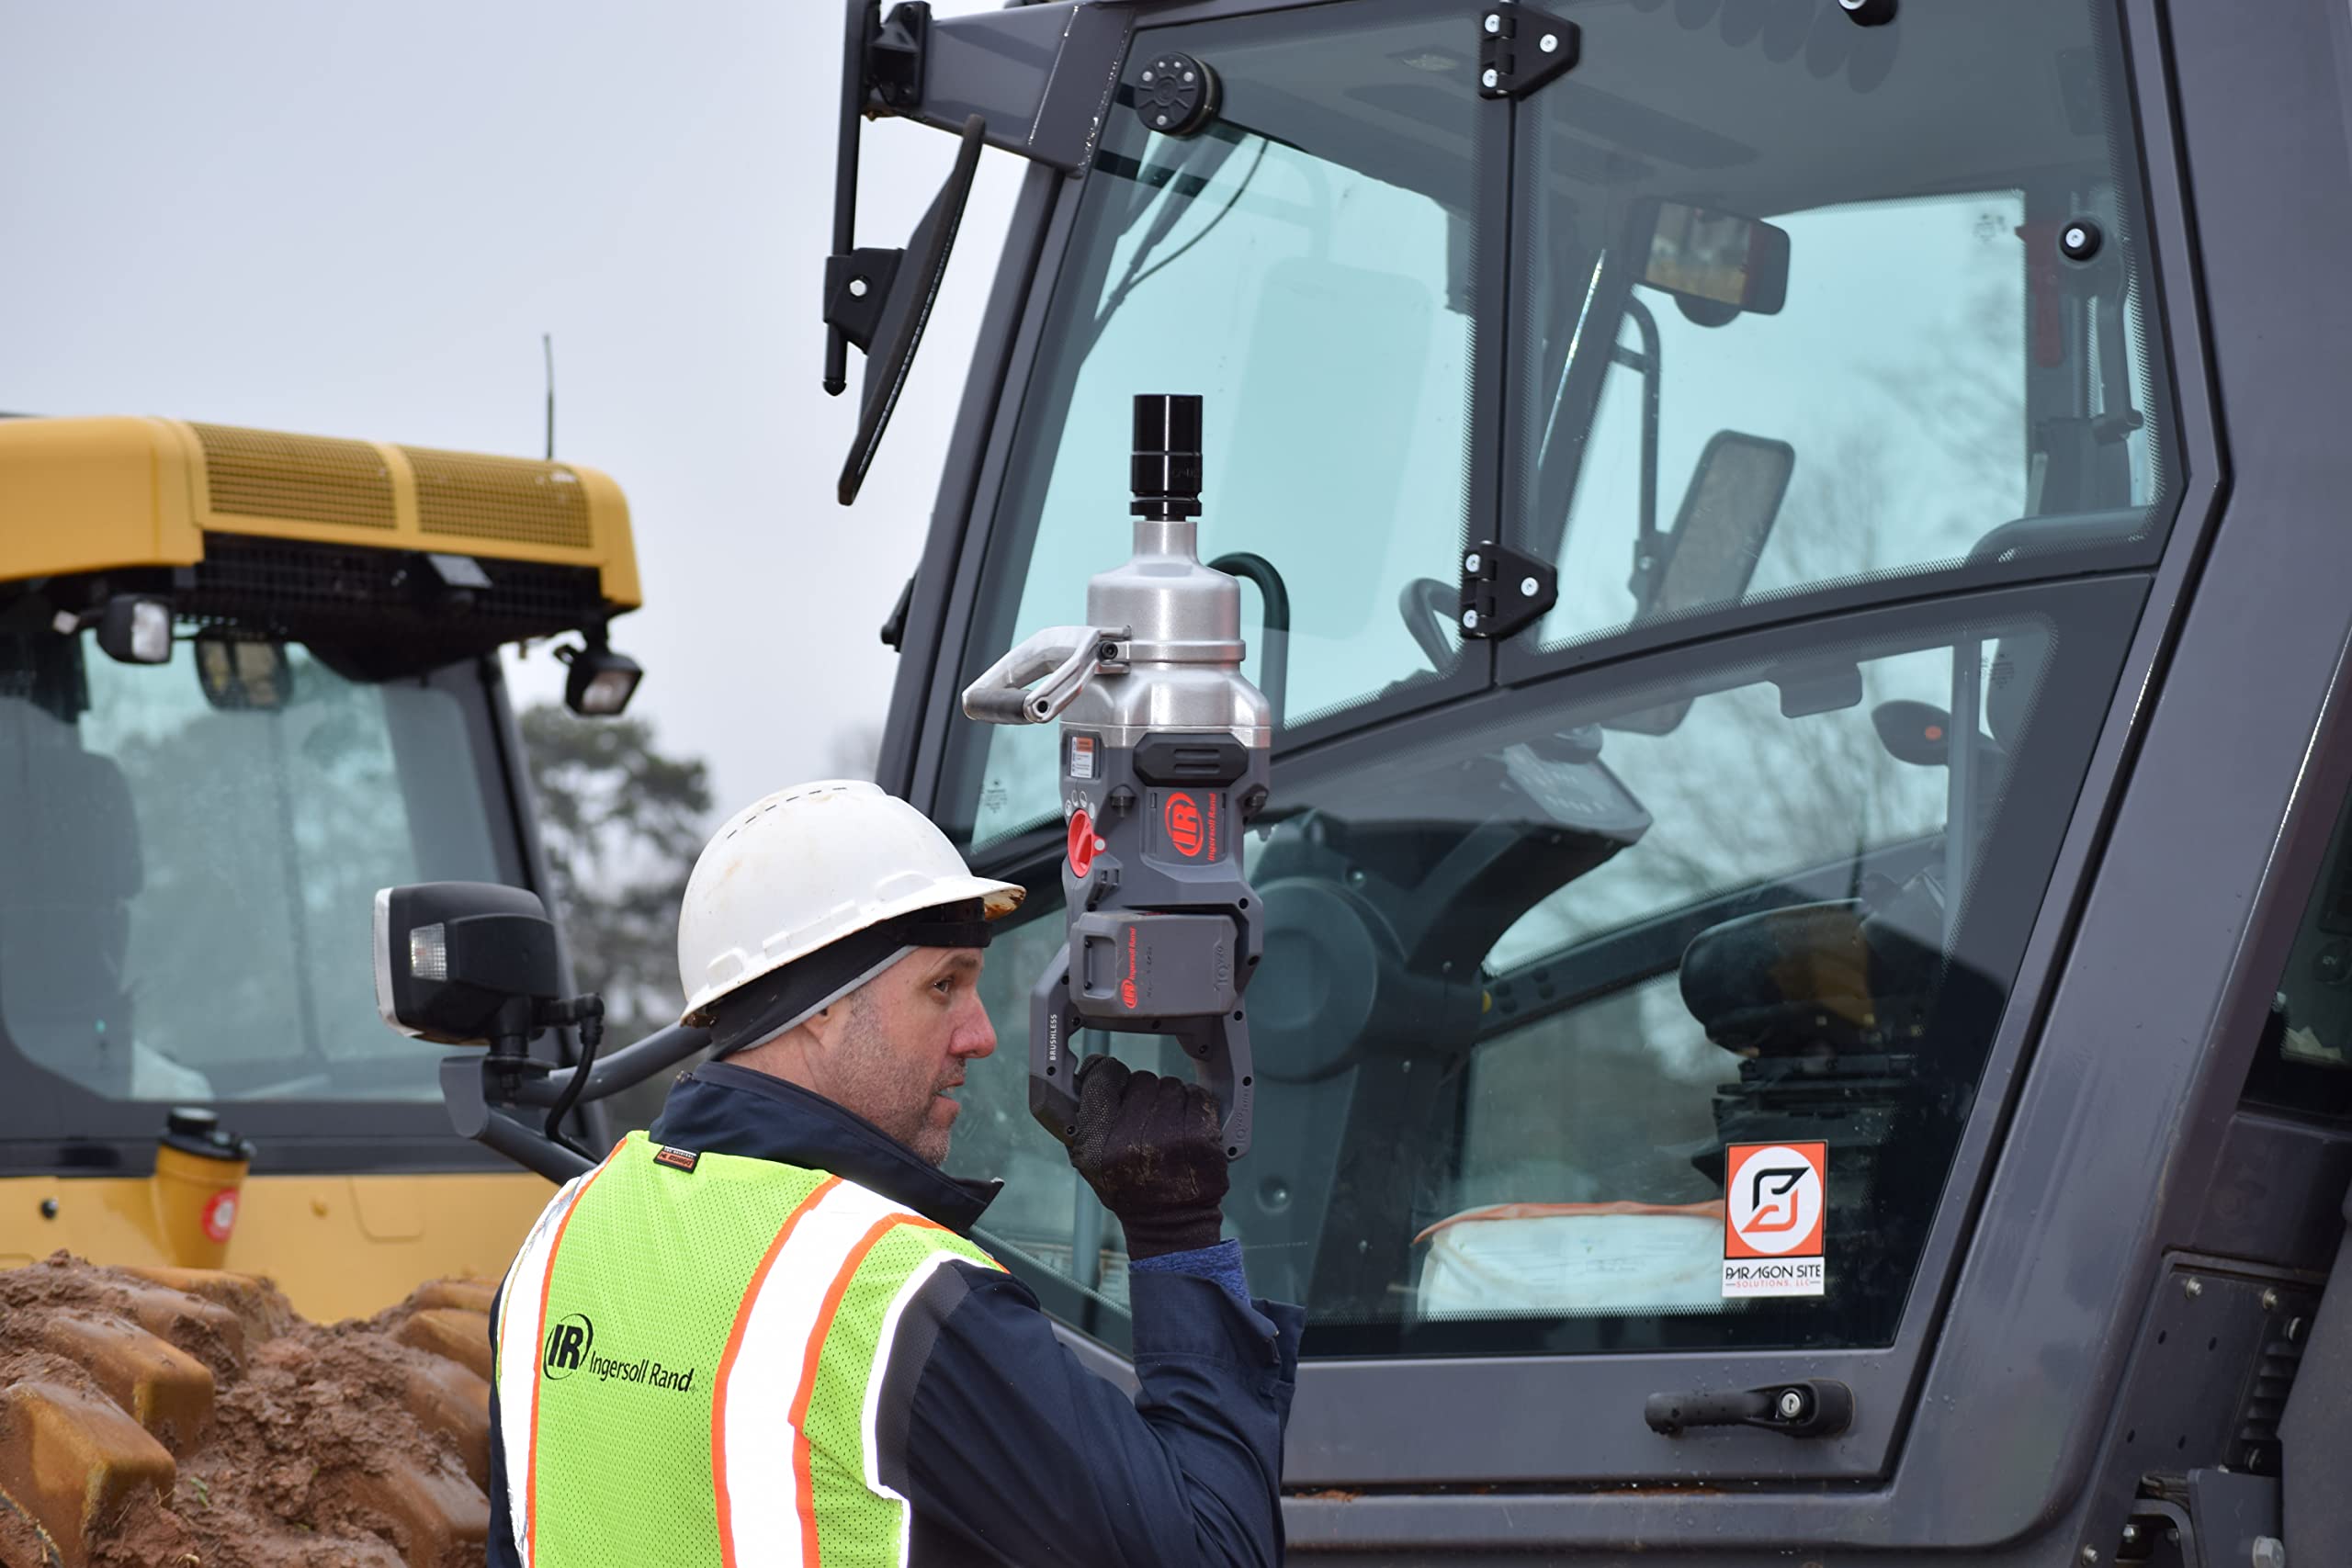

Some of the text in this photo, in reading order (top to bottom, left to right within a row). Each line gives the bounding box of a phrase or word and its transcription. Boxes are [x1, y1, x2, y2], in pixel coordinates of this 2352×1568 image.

[1170, 800, 1199, 849] IR
[1207, 794, 1216, 861] Ingersoll Rand
[1049, 1014, 1057, 1061] BRUSHLESS
[1725, 1264, 1821, 1280] PARAGON SITE
[1795, 1279, 1810, 1287] LLC
[547, 1321, 694, 1393] IR Ingersoll Rand
